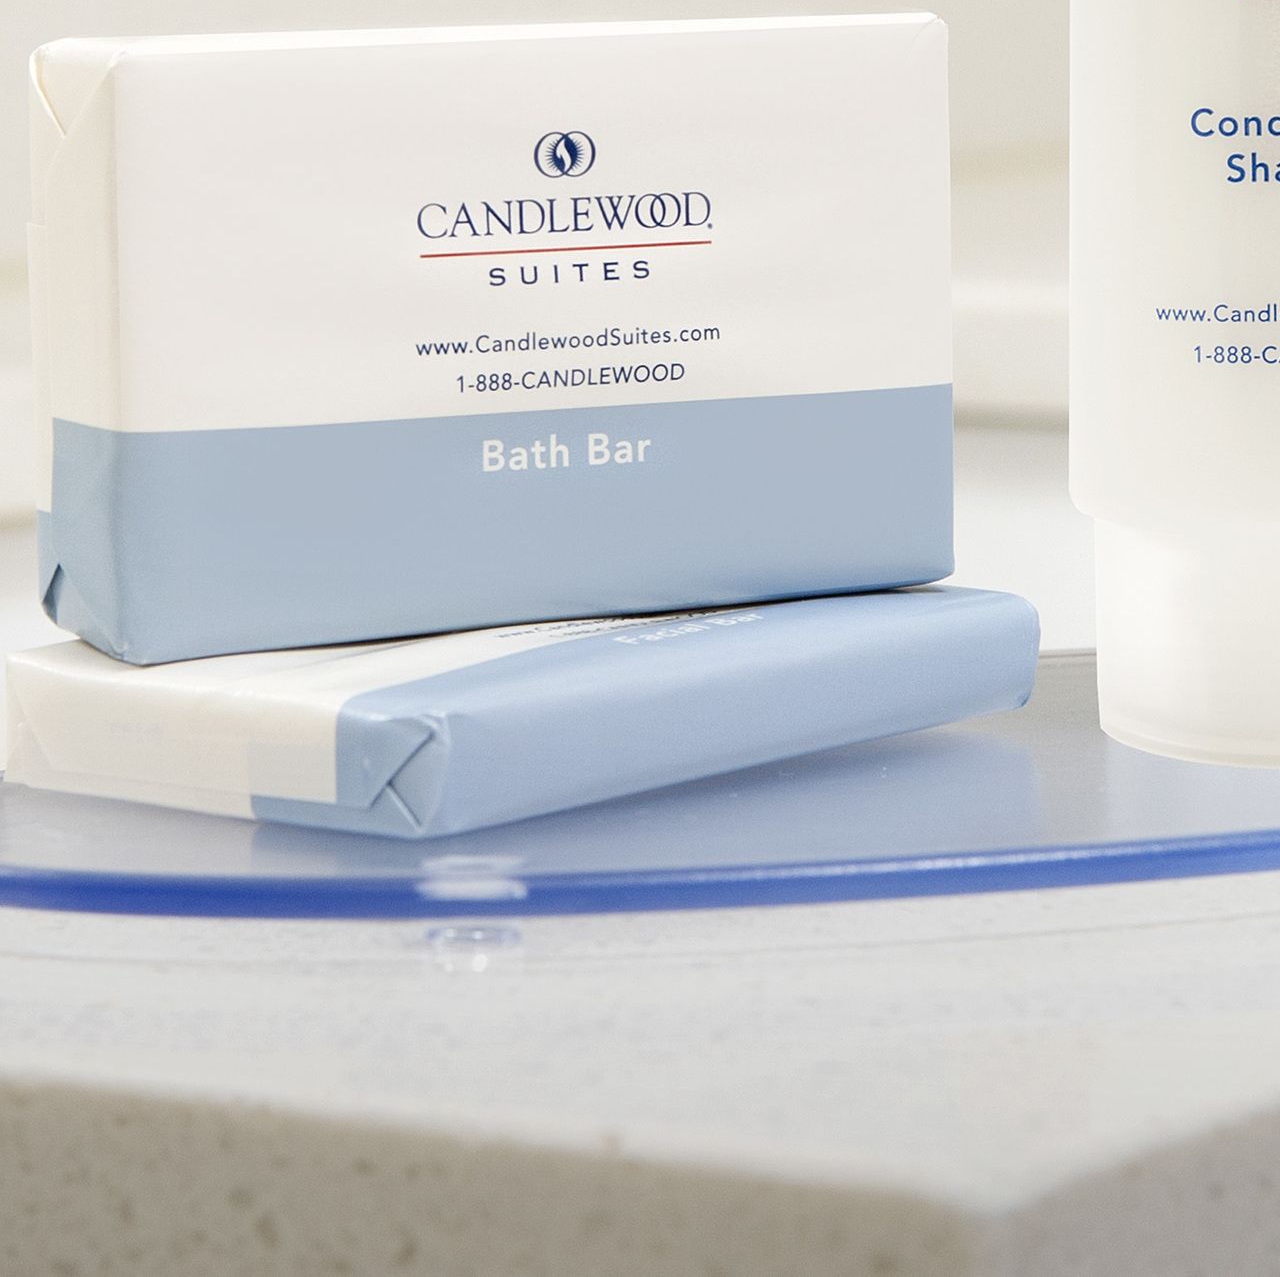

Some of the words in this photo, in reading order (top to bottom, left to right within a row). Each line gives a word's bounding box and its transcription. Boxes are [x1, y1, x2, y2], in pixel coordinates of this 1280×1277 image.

[417, 191, 713, 239] CANDLEWOOD
[488, 260, 651, 287] SUITES
[415, 326, 721, 356] www.CandlewoodSuites.com
[456, 363, 686, 394] 1-888-CANDLEWOOD
[481, 433, 570, 472] Bath
[587, 432, 652, 466] Bar
[613, 623, 710, 645] Facial
[704, 613, 763, 627] Bar
